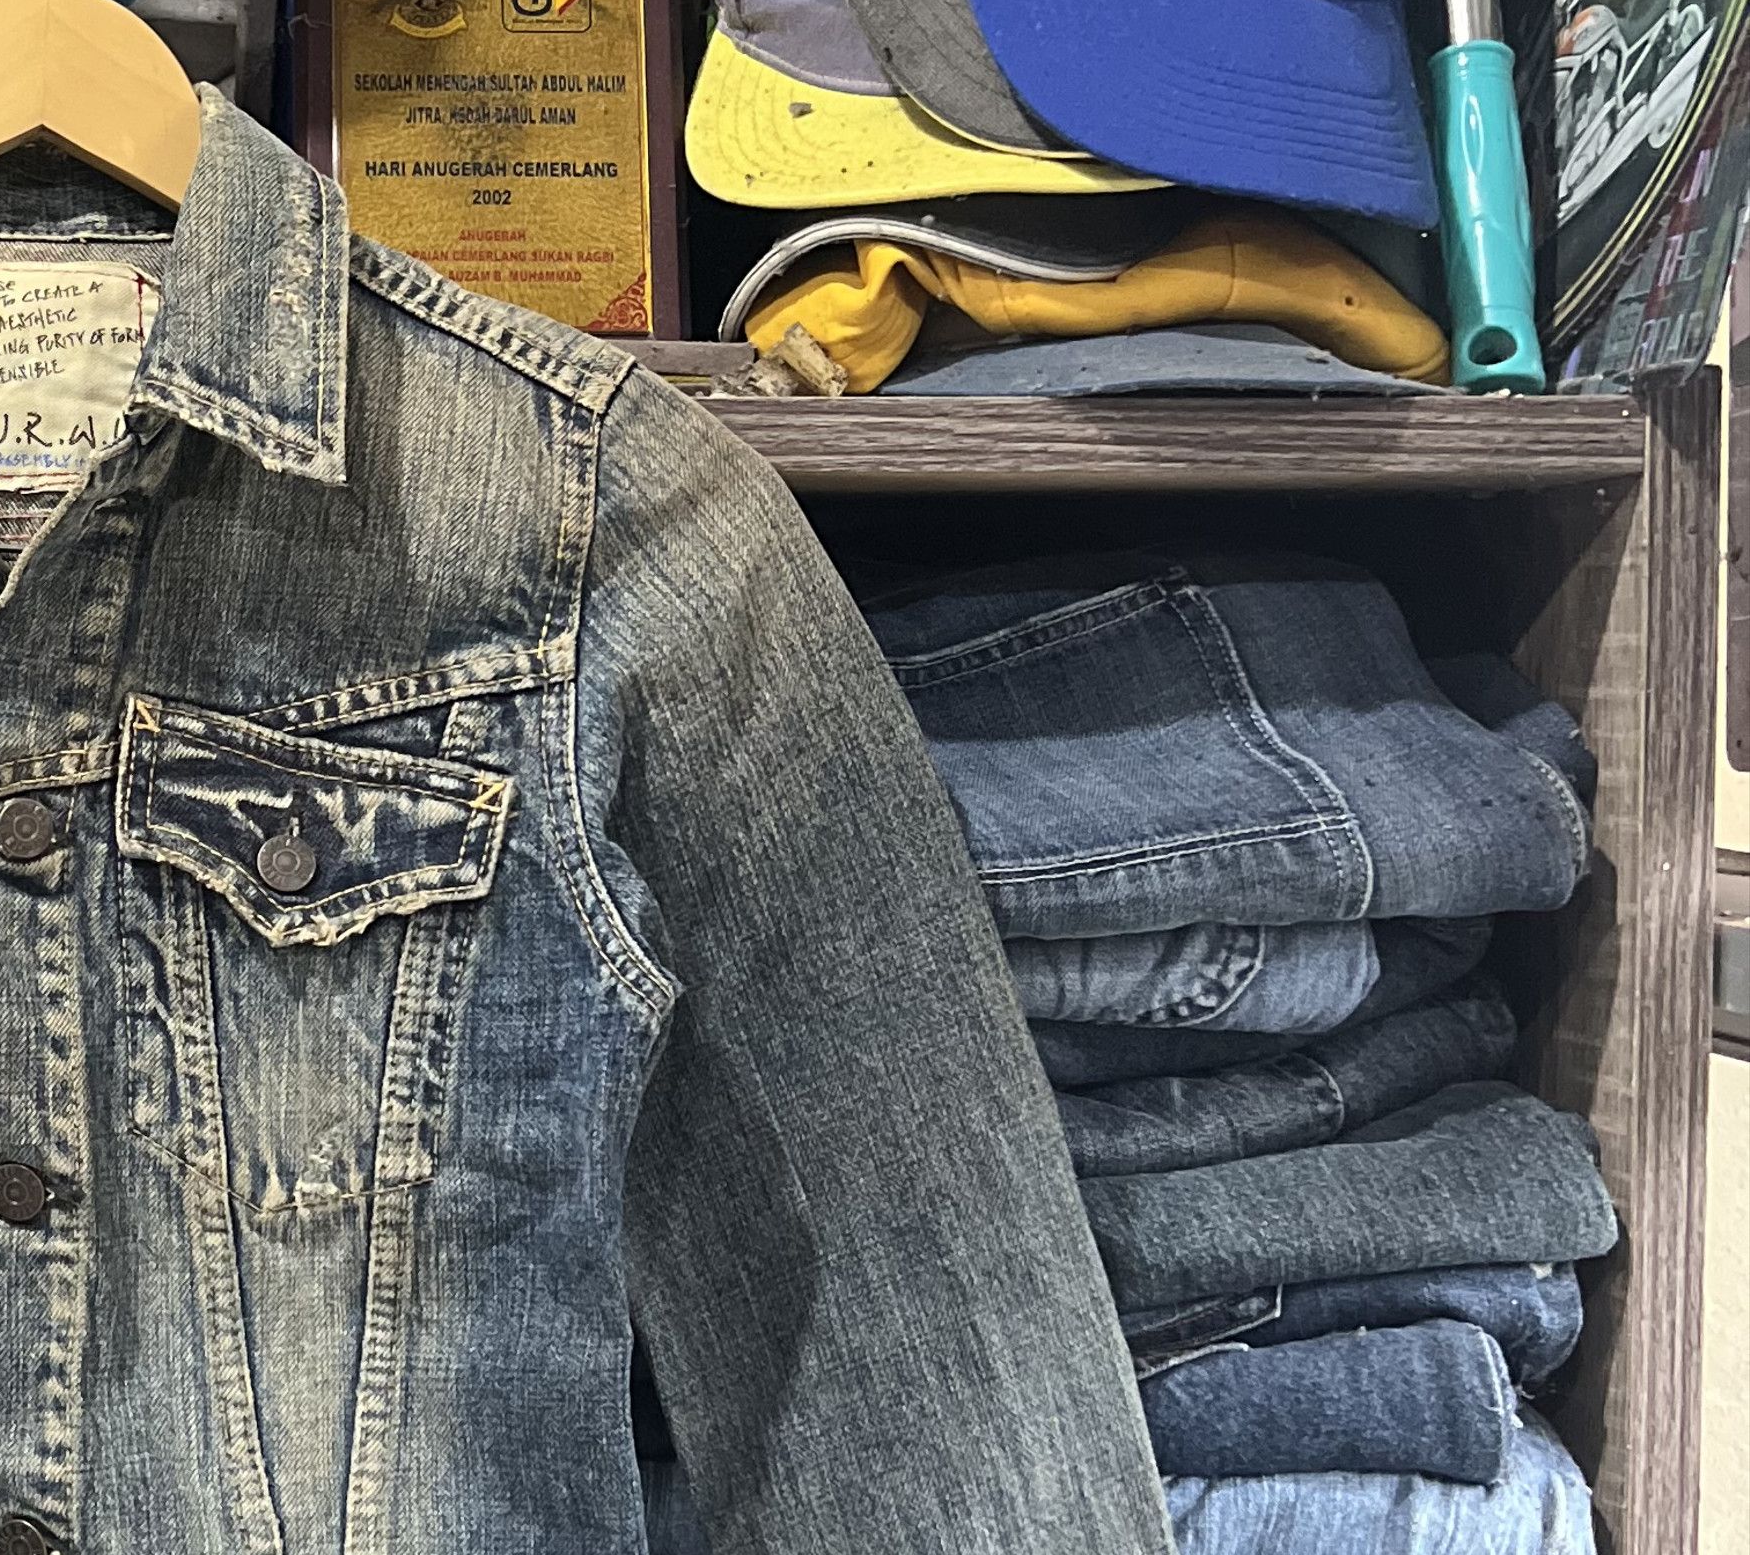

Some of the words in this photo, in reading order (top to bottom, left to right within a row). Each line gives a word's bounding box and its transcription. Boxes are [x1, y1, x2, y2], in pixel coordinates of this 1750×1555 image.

[354, 74, 412, 93] SEKOLAH
[541, 75, 583, 93] ABDUL
[587, 75, 626, 93] HALIM
[539, 107, 576, 125] AMAN
[365, 161, 406, 177] HARI
[412, 161, 507, 177] ANUGERAH
[512, 161, 619, 177] CEMERLANG
[472, 189, 512, 205] 2002
[458, 230, 527, 242] ANUGERAH
[453, 251, 528, 262] CEMERLANG
[531, 251, 574, 263] SUKAN
[509, 271, 582, 283] MUHAMMAD
[21, 285, 84, 303] CREATE
[35, 329, 87, 353] PURITY
[89, 327, 106, 346] OF
